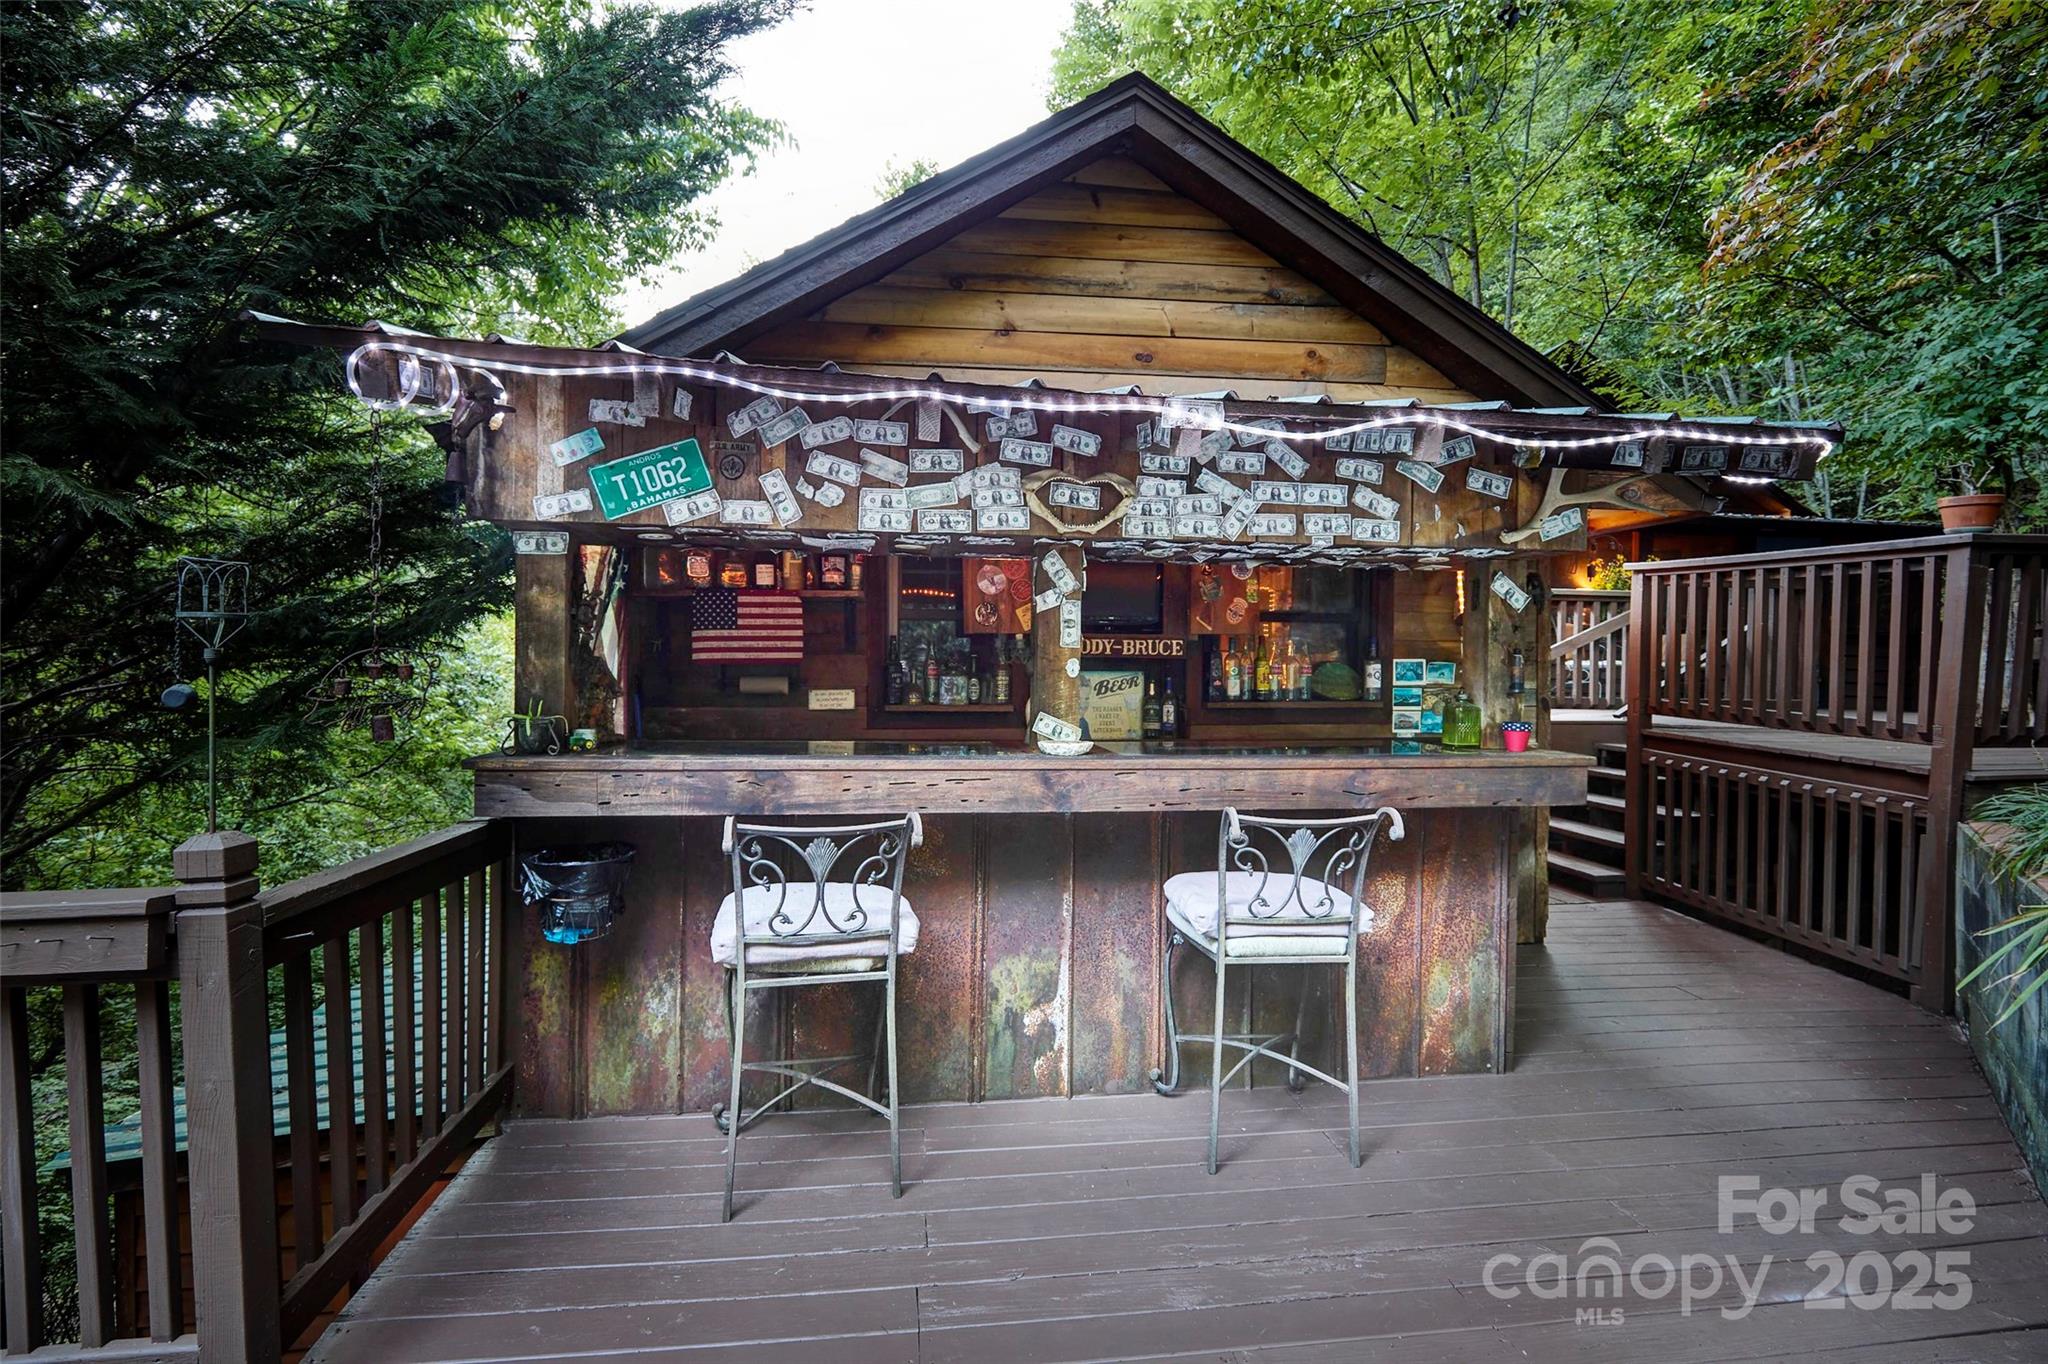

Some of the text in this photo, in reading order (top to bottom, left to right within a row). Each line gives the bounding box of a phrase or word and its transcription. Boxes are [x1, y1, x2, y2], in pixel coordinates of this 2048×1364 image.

[729, 443, 750, 451] ARMY
[629, 453, 662, 466] ANDROS
[611, 456, 692, 501] T1062
[630, 486, 687, 508] BAHAMAS
